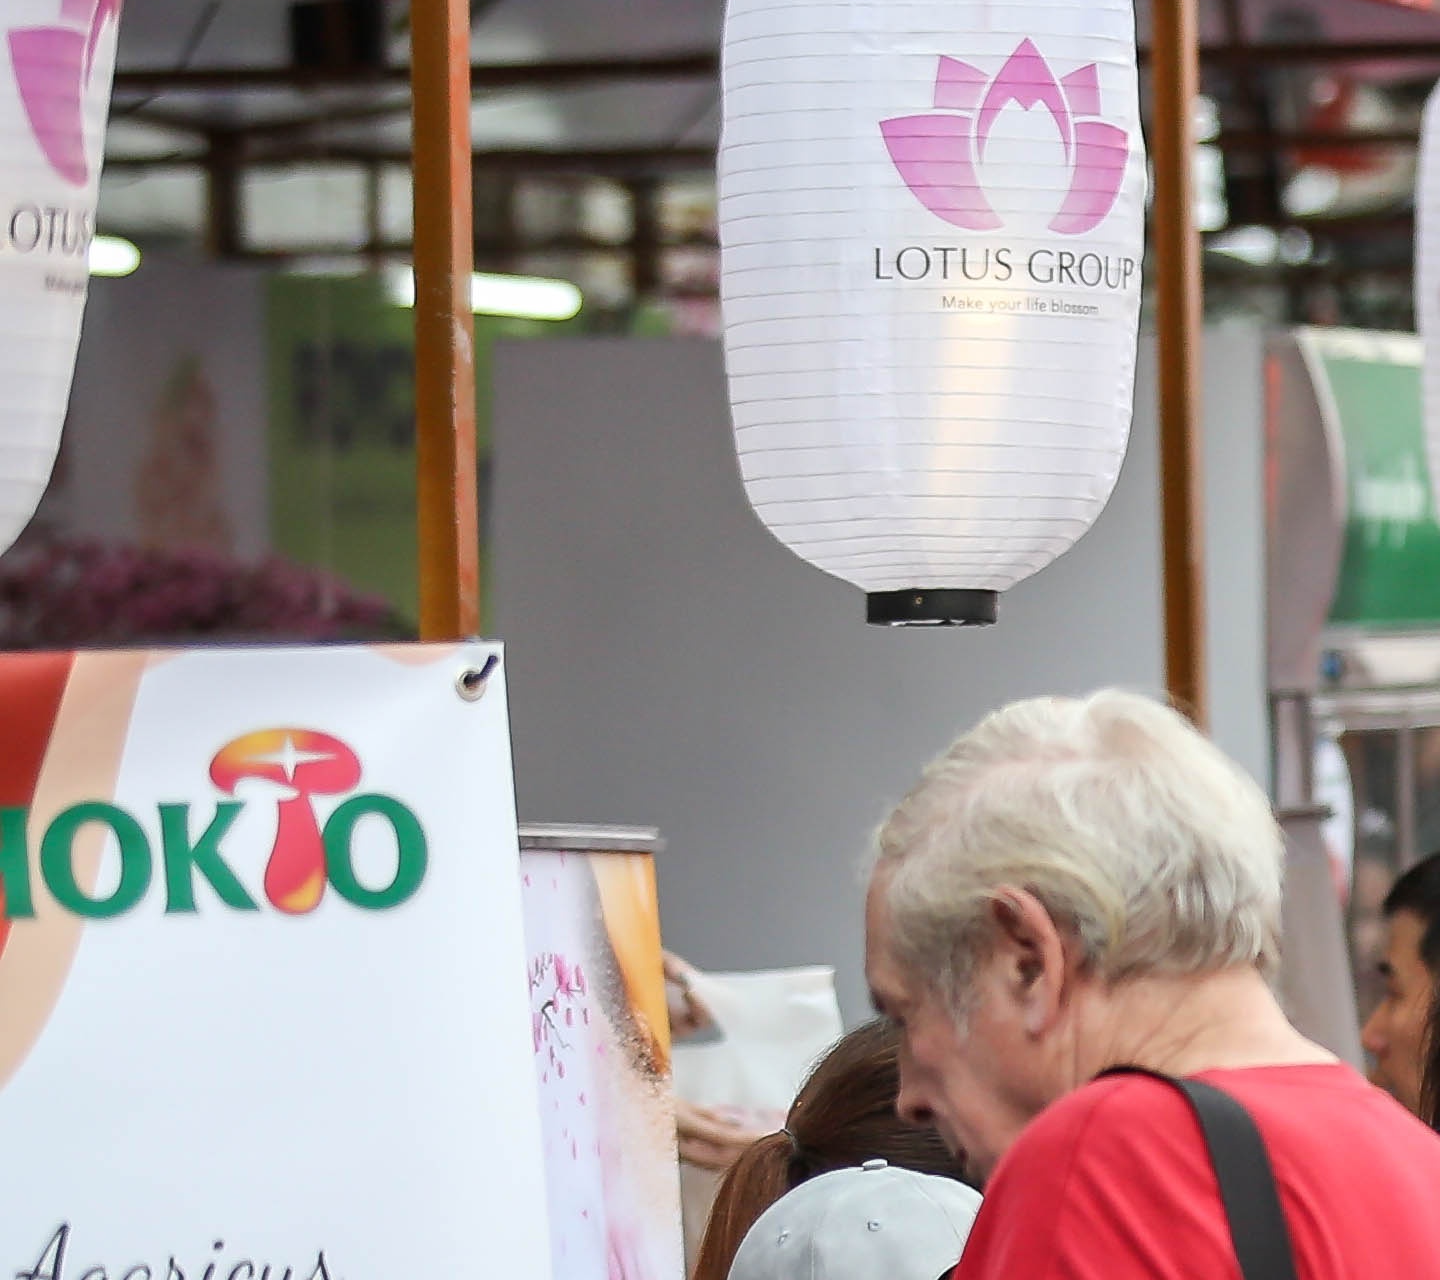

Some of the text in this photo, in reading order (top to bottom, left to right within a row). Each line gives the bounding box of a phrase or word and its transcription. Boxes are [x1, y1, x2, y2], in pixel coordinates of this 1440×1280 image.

[874, 246, 1134, 290] LOTUS GROUP
[942, 295, 1099, 314] Make your life blossom
